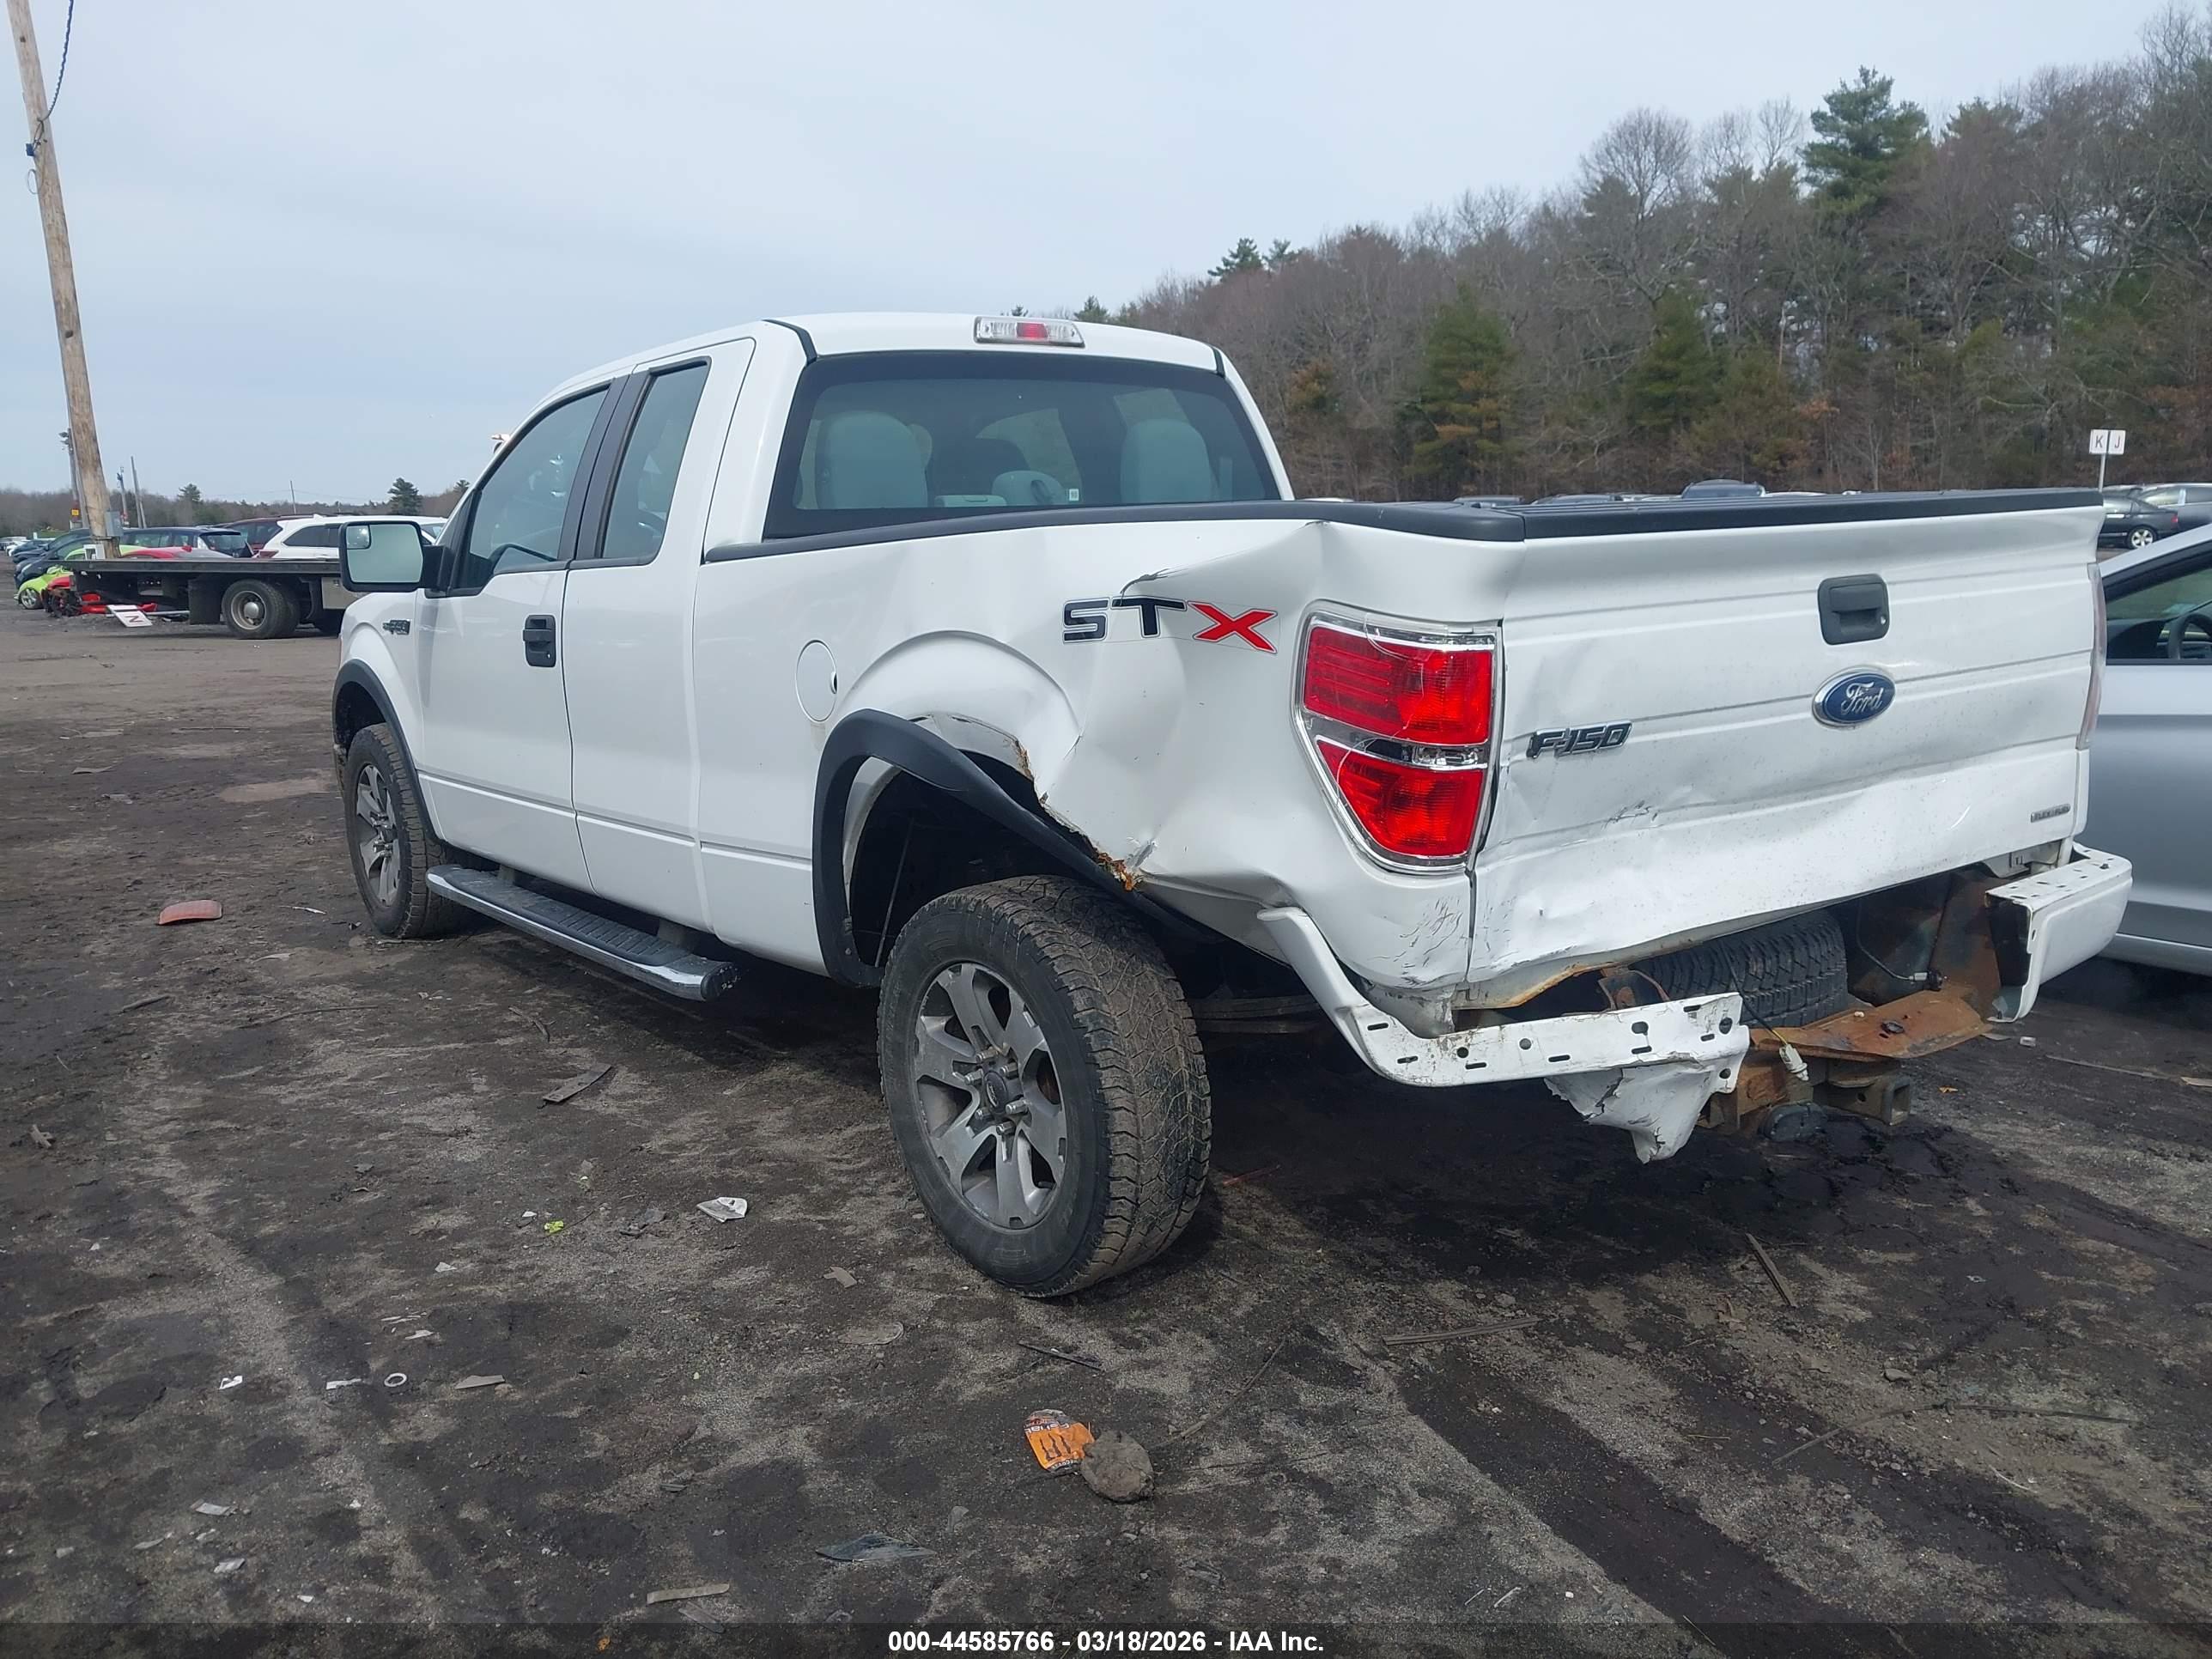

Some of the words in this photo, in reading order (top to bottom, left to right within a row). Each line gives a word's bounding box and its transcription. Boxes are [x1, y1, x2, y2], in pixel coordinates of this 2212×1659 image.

[2094, 435, 2103, 448] K
[2114, 435, 2121, 448] J
[1062, 595, 1277, 654] STX
[1840, 681, 1885, 716] Ford
[1526, 720, 1632, 759] F-150
